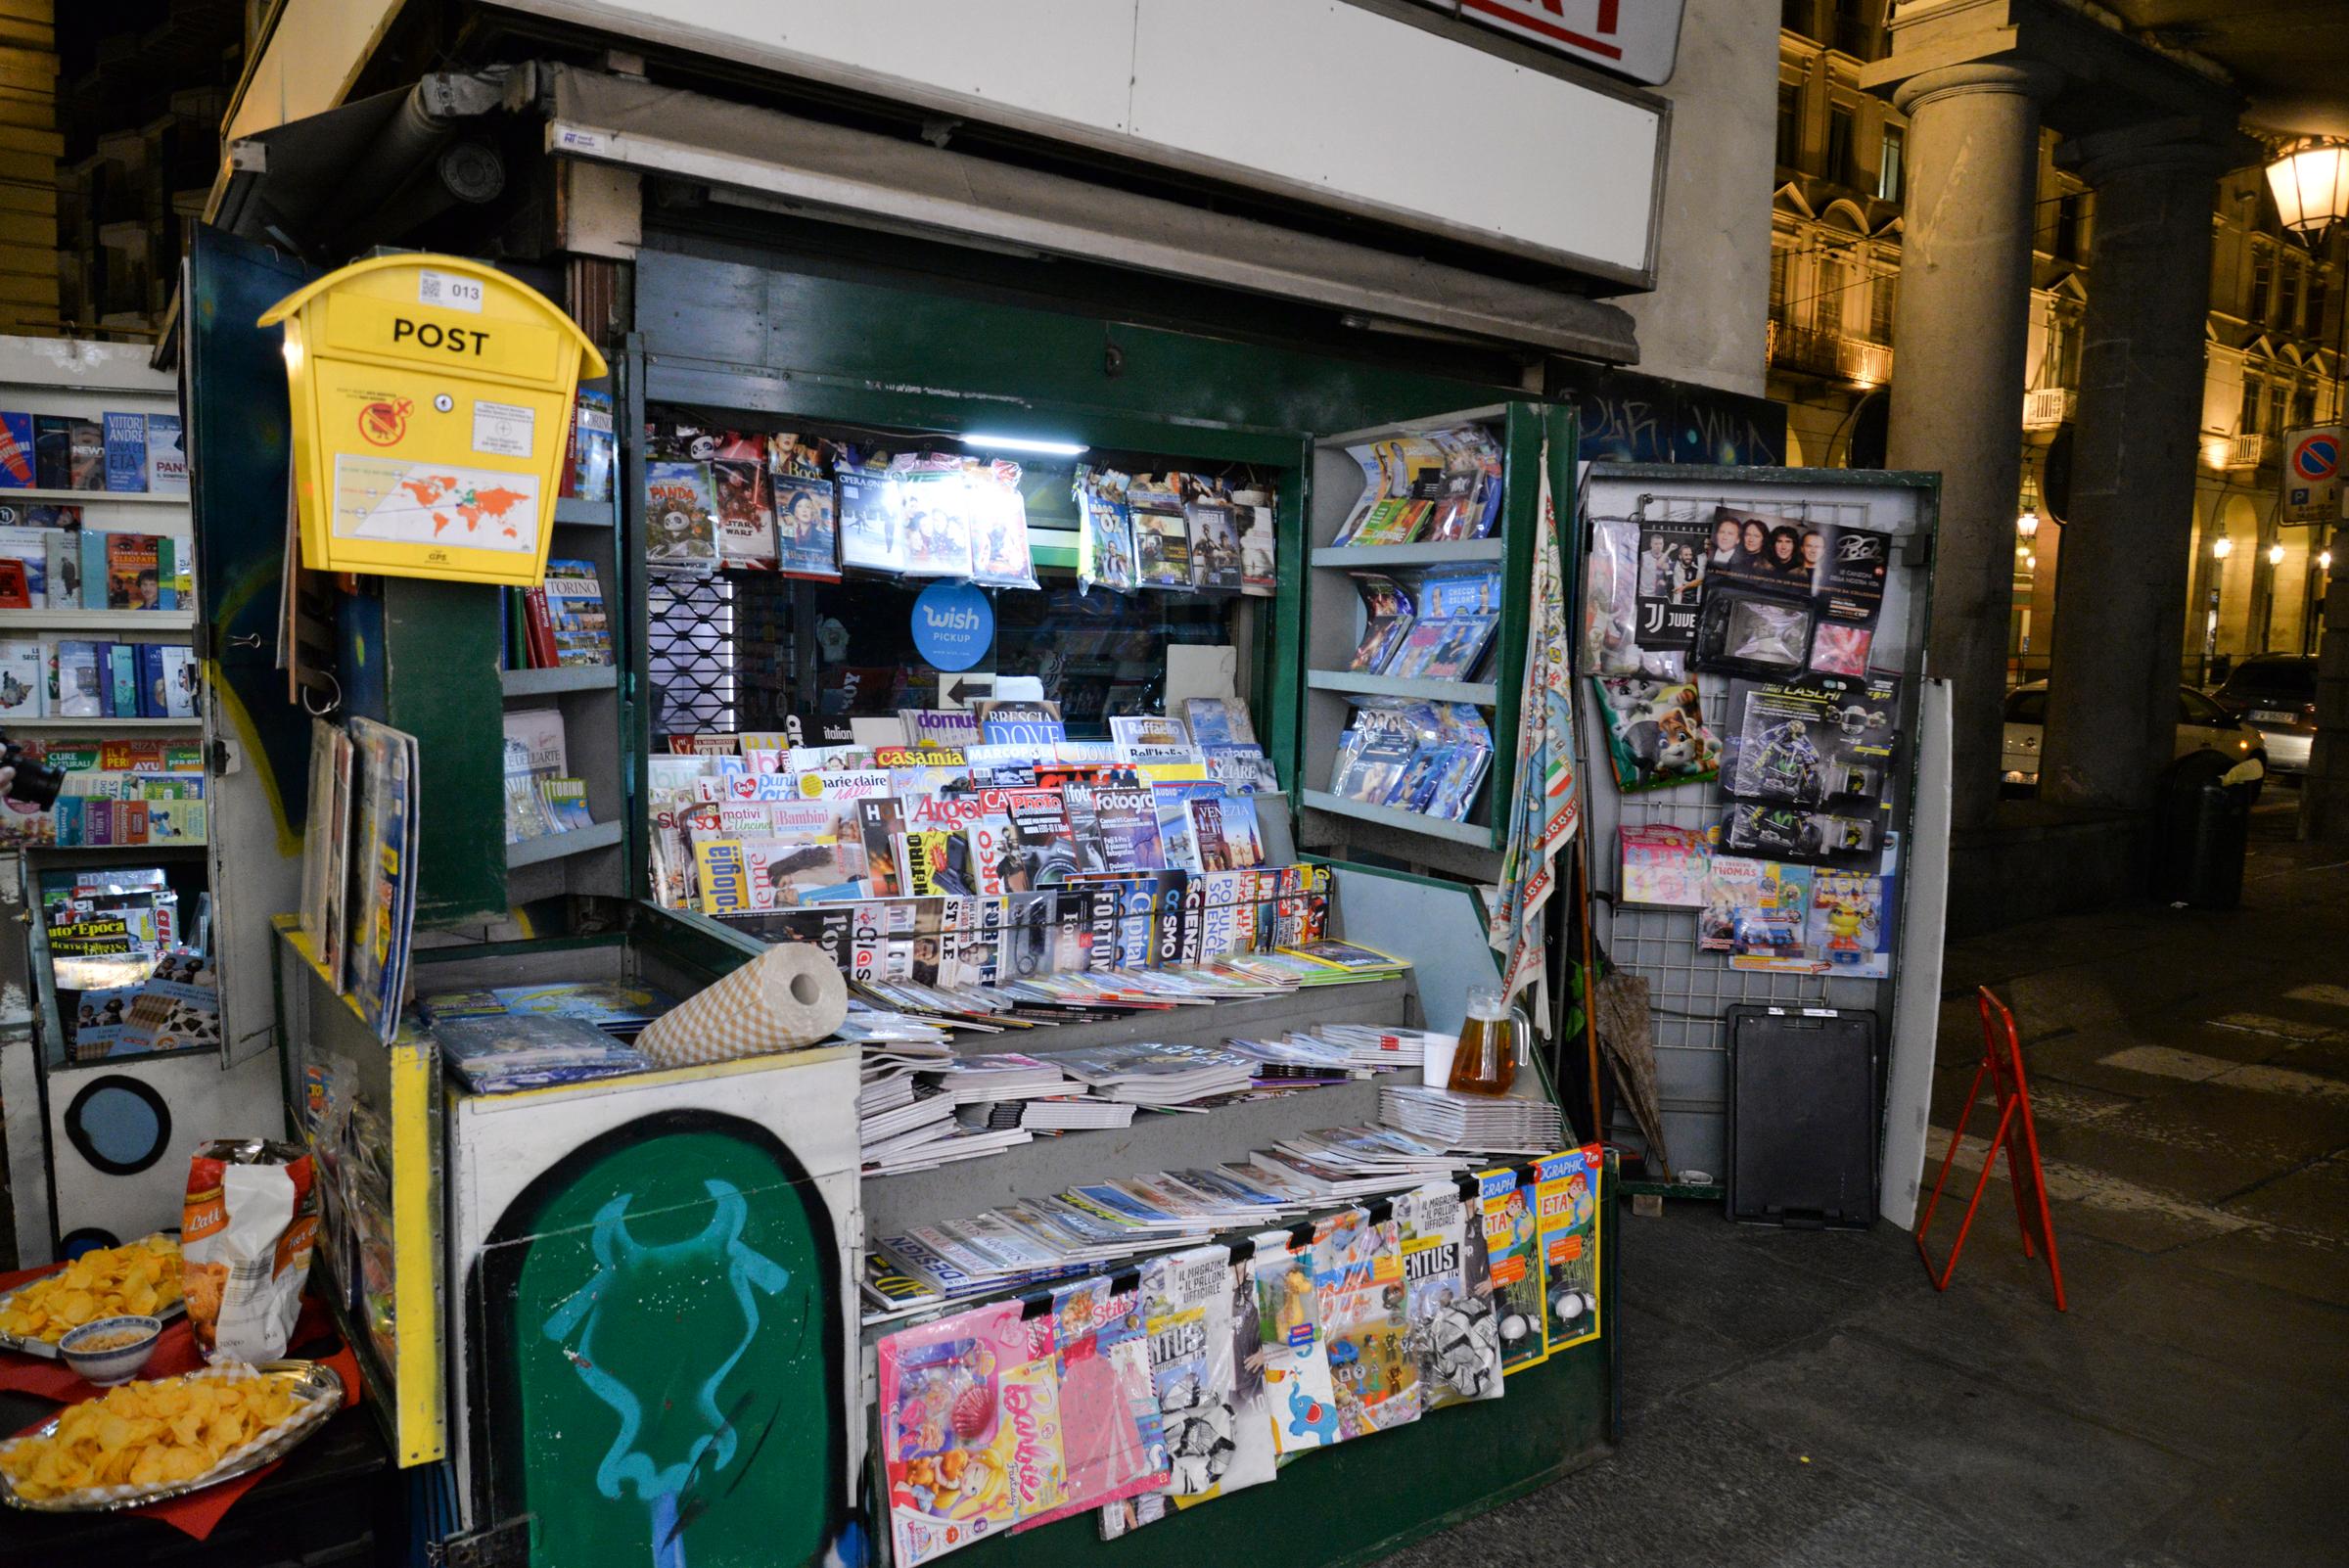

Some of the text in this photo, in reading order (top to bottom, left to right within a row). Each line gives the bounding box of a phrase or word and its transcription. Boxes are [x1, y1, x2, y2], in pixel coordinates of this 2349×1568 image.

[452, 284, 481, 301] 013
[393, 318, 489, 355] POST
[650, 487, 695, 502] PANDA
[726, 520, 753, 529] STAR
[726, 529, 753, 537] WARS
[549, 579, 599, 595] TORINO
[923, 603, 980, 632] wish
[1668, 613, 1697, 628] JUVE
[933, 631, 971, 643] PICKUP
[917, 710, 979, 728] domus
[989, 712, 1052, 722] BRESCIA
[823, 725, 852, 740] italian
[989, 725, 1060, 745] DOVE
[1128, 722, 1179, 735] Raffaello
[878, 747, 966, 766] casamia
[552, 779, 584, 797] TORINO
[853, 774, 887, 787] claire
[1012, 795, 1062, 809] Photo
[722, 808, 760, 820] motivi
[1199, 806, 1250, 818] VENEZIA
[979, 830, 1000, 896] ARCO
[1713, 866, 1757, 877] THOMAS
[1203, 883, 1221, 957] SCENCE
[943, 901, 958, 960] STYLE
[1124, 892, 1152, 967] Capital
[1428, 1192, 1460, 1209] MAGAZINE
[1541, 1194, 1568, 1217] ETA
[1433, 1204, 1460, 1219] PALLONE
[1424, 1214, 1456, 1231] UFFICIALE
[884, 1236, 965, 1280] DESIGN
[1404, 1244, 1454, 1280] ENTUS
[1187, 1258, 1227, 1278] MAGAZINE
[1193, 1268, 1227, 1289] PALLONE
[1183, 1285, 1221, 1304] UFFICIALE
[1003, 1376, 1059, 1502] Barbie
[1006, 1462, 1020, 1507] Fantasy
